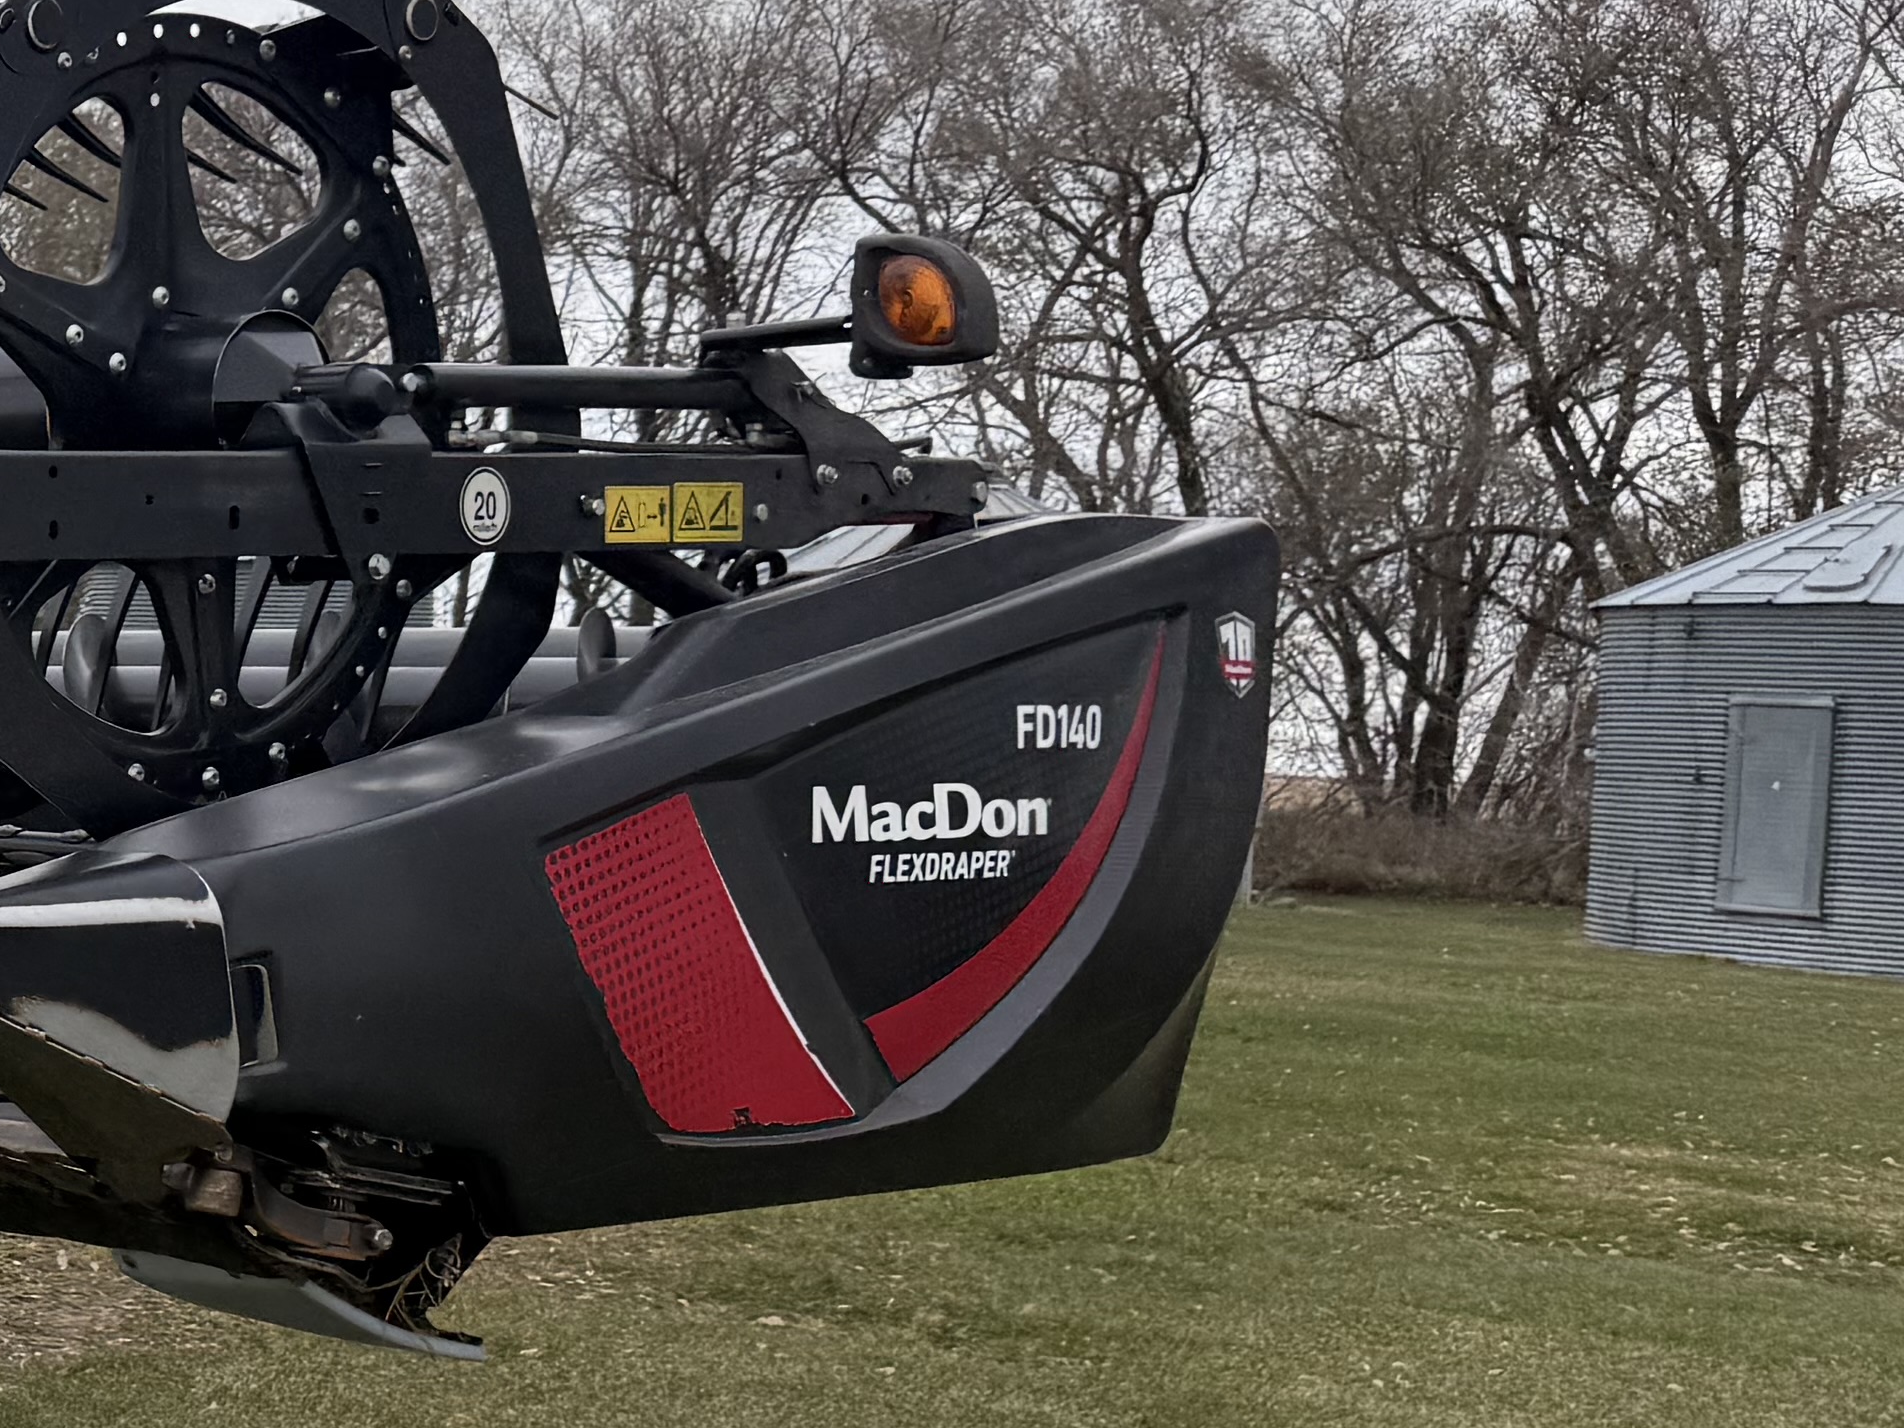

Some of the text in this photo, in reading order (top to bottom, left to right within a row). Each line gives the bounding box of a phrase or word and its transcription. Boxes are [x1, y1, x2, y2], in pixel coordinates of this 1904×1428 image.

[474, 491, 497, 521] 20
[1016, 704, 1102, 749] FD140
[811, 783, 1049, 844] MacDon
[869, 850, 1011, 884] FLEXDRAPER
